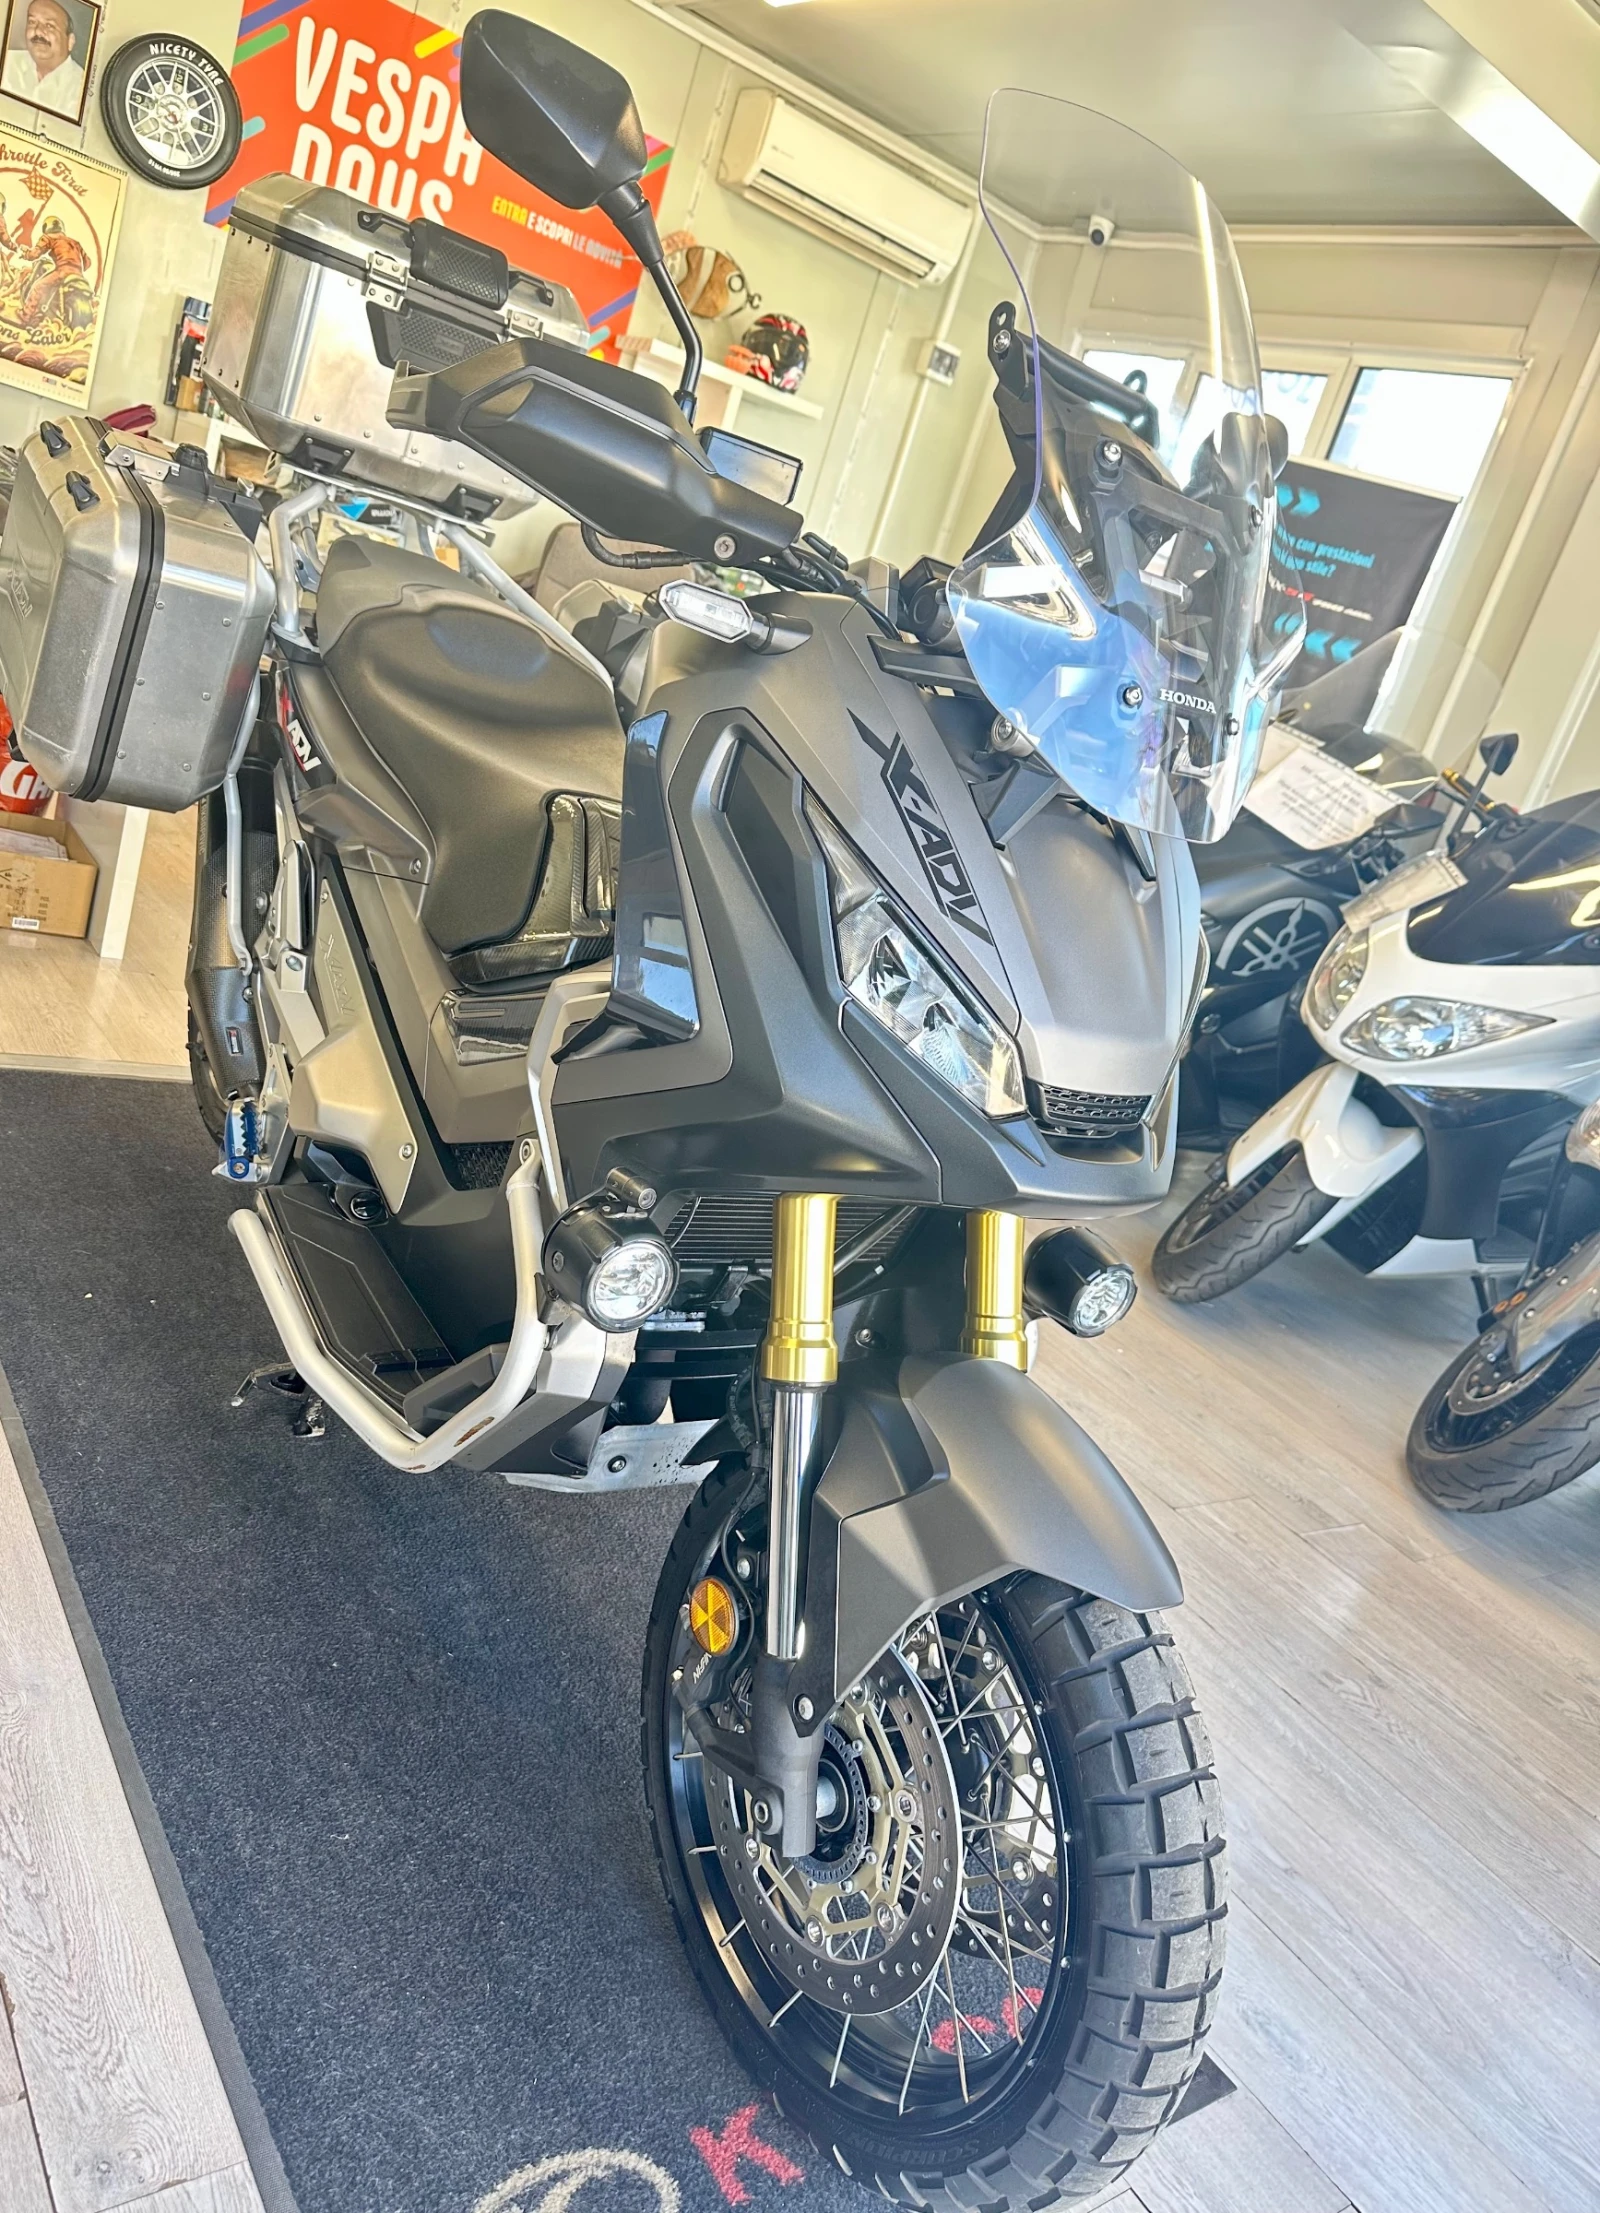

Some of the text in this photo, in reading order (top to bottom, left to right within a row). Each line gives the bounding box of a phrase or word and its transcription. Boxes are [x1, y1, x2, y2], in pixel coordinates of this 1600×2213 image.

[149, 42, 225, 86] NICETY TYRE
[51, 161, 88, 197] First
[491, 195, 529, 227] ENTRA
[526, 211, 538, 231] E
[534, 215, 575, 248] SCOPRI
[572, 232, 588, 254] LE
[24, 326, 72, 346] Later
[1159, 688, 1217, 715] HONDA
